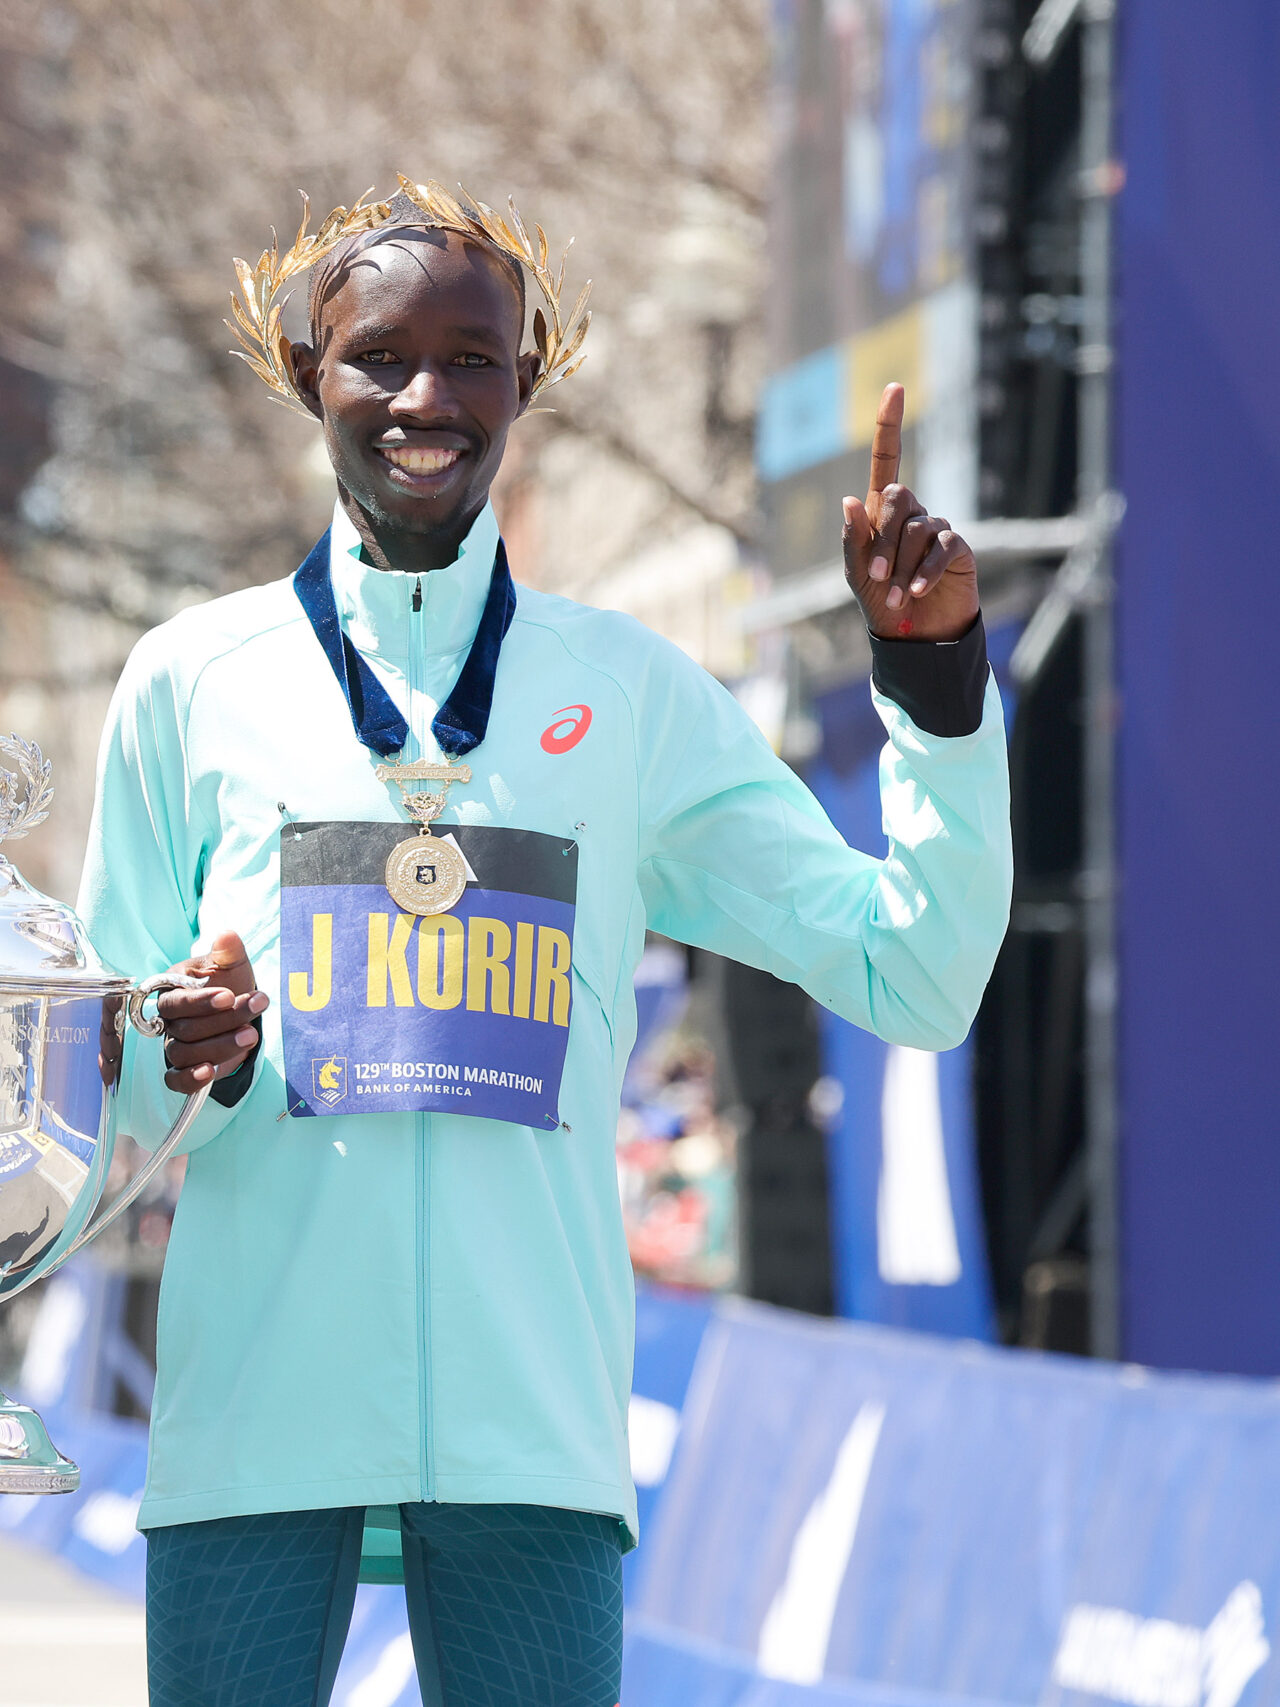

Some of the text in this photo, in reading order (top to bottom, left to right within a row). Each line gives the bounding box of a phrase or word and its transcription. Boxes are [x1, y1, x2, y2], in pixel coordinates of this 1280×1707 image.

[288, 912, 571, 1028] J KORIR
[354, 1062, 544, 1095] 129TH BOSTON MARATHON
[356, 1083, 472, 1097] BANK OF AMERICA
